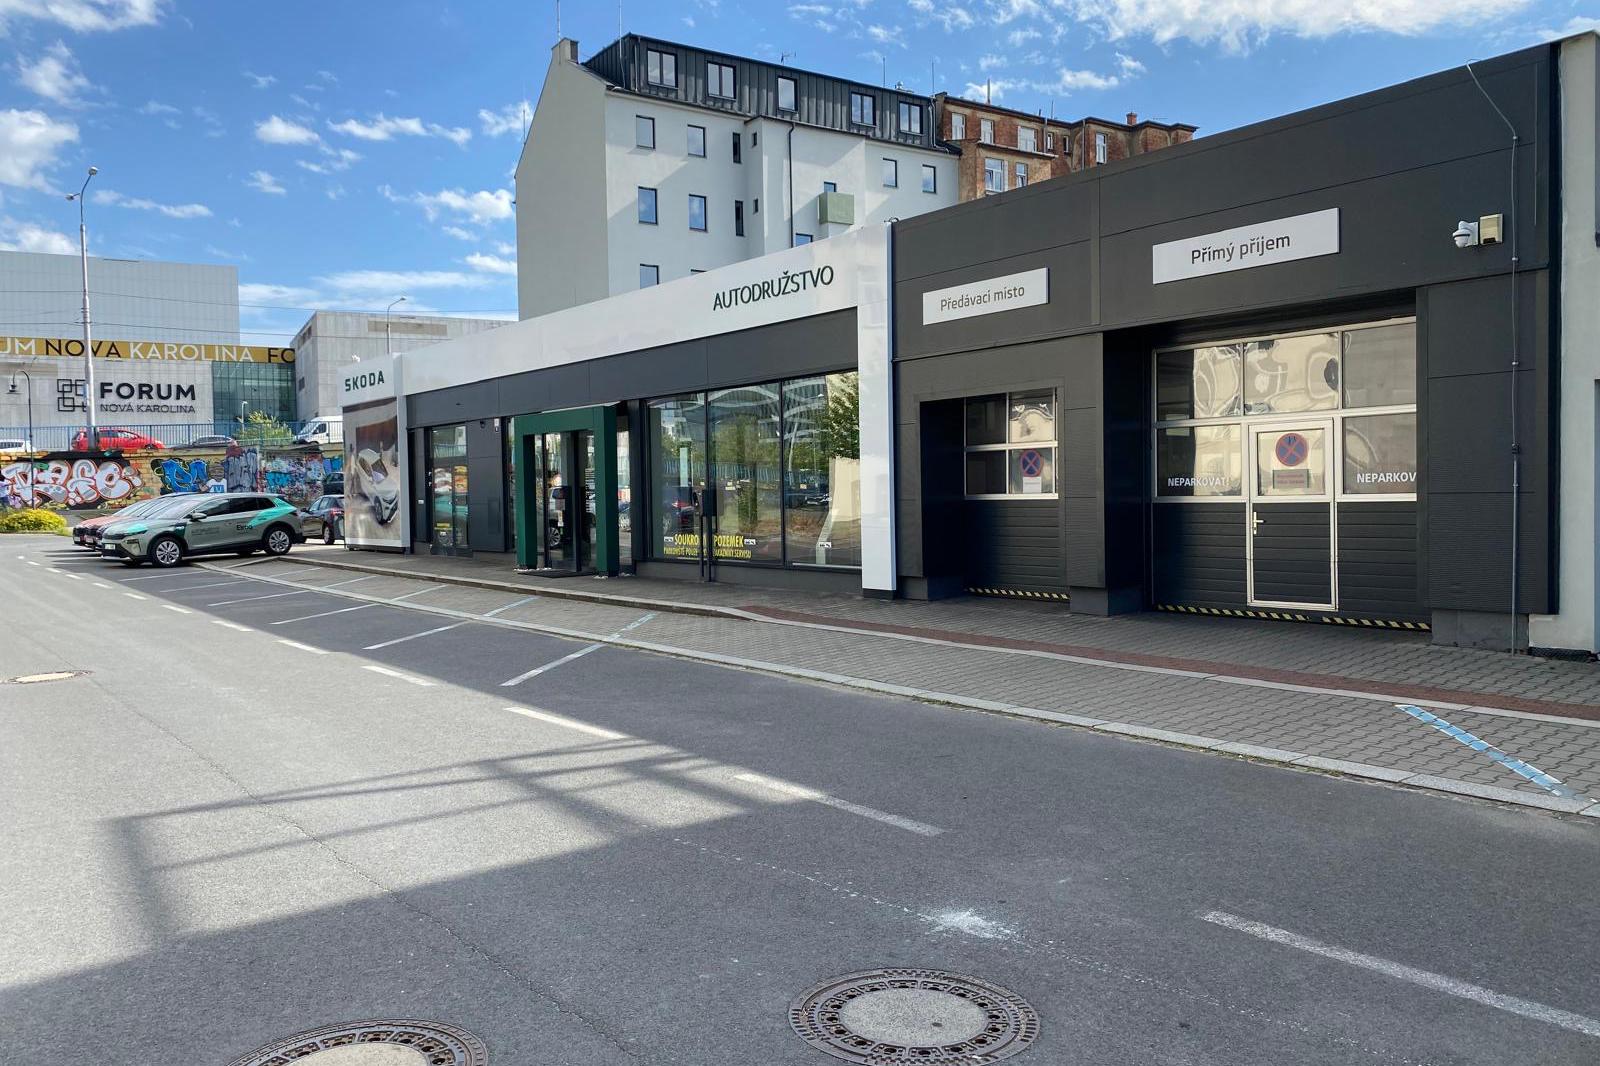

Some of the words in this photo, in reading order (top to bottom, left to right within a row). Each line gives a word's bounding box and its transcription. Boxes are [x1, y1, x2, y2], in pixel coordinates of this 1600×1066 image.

[1191, 241, 1235, 265] Přímý
[1239, 235, 1290, 260] příjem
[713, 265, 834, 311] AUTODRUŽSTVO
[940, 289, 991, 312] Předávací
[993, 286, 1025, 302] místo
[128, 341, 254, 362] KAROLINA
[100, 382, 196, 401] FORUM
[136, 403, 196, 414] KAROLINA
[714, 535, 744, 548] POZEMEK
